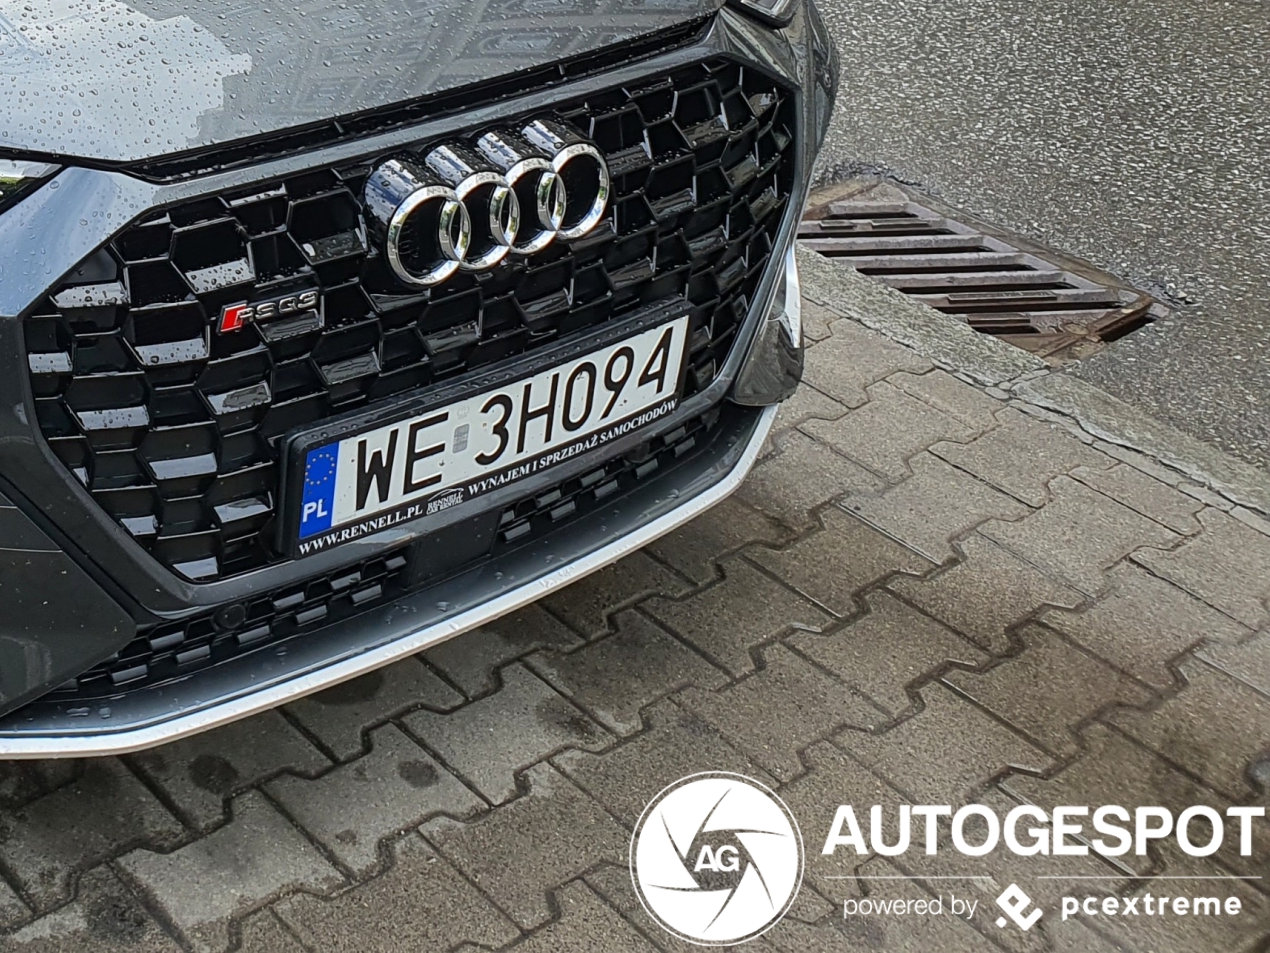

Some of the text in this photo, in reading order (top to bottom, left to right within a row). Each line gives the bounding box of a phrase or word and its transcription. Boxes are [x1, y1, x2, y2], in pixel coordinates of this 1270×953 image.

[355, 327, 673, 511] WE 3H094
[468, 398, 678, 496] WYNAJEM I SPRZEDAŻ SAMOCHODÓW
[299, 504, 423, 555] WWW.RENNELL.PL
[302, 498, 328, 523] PL
